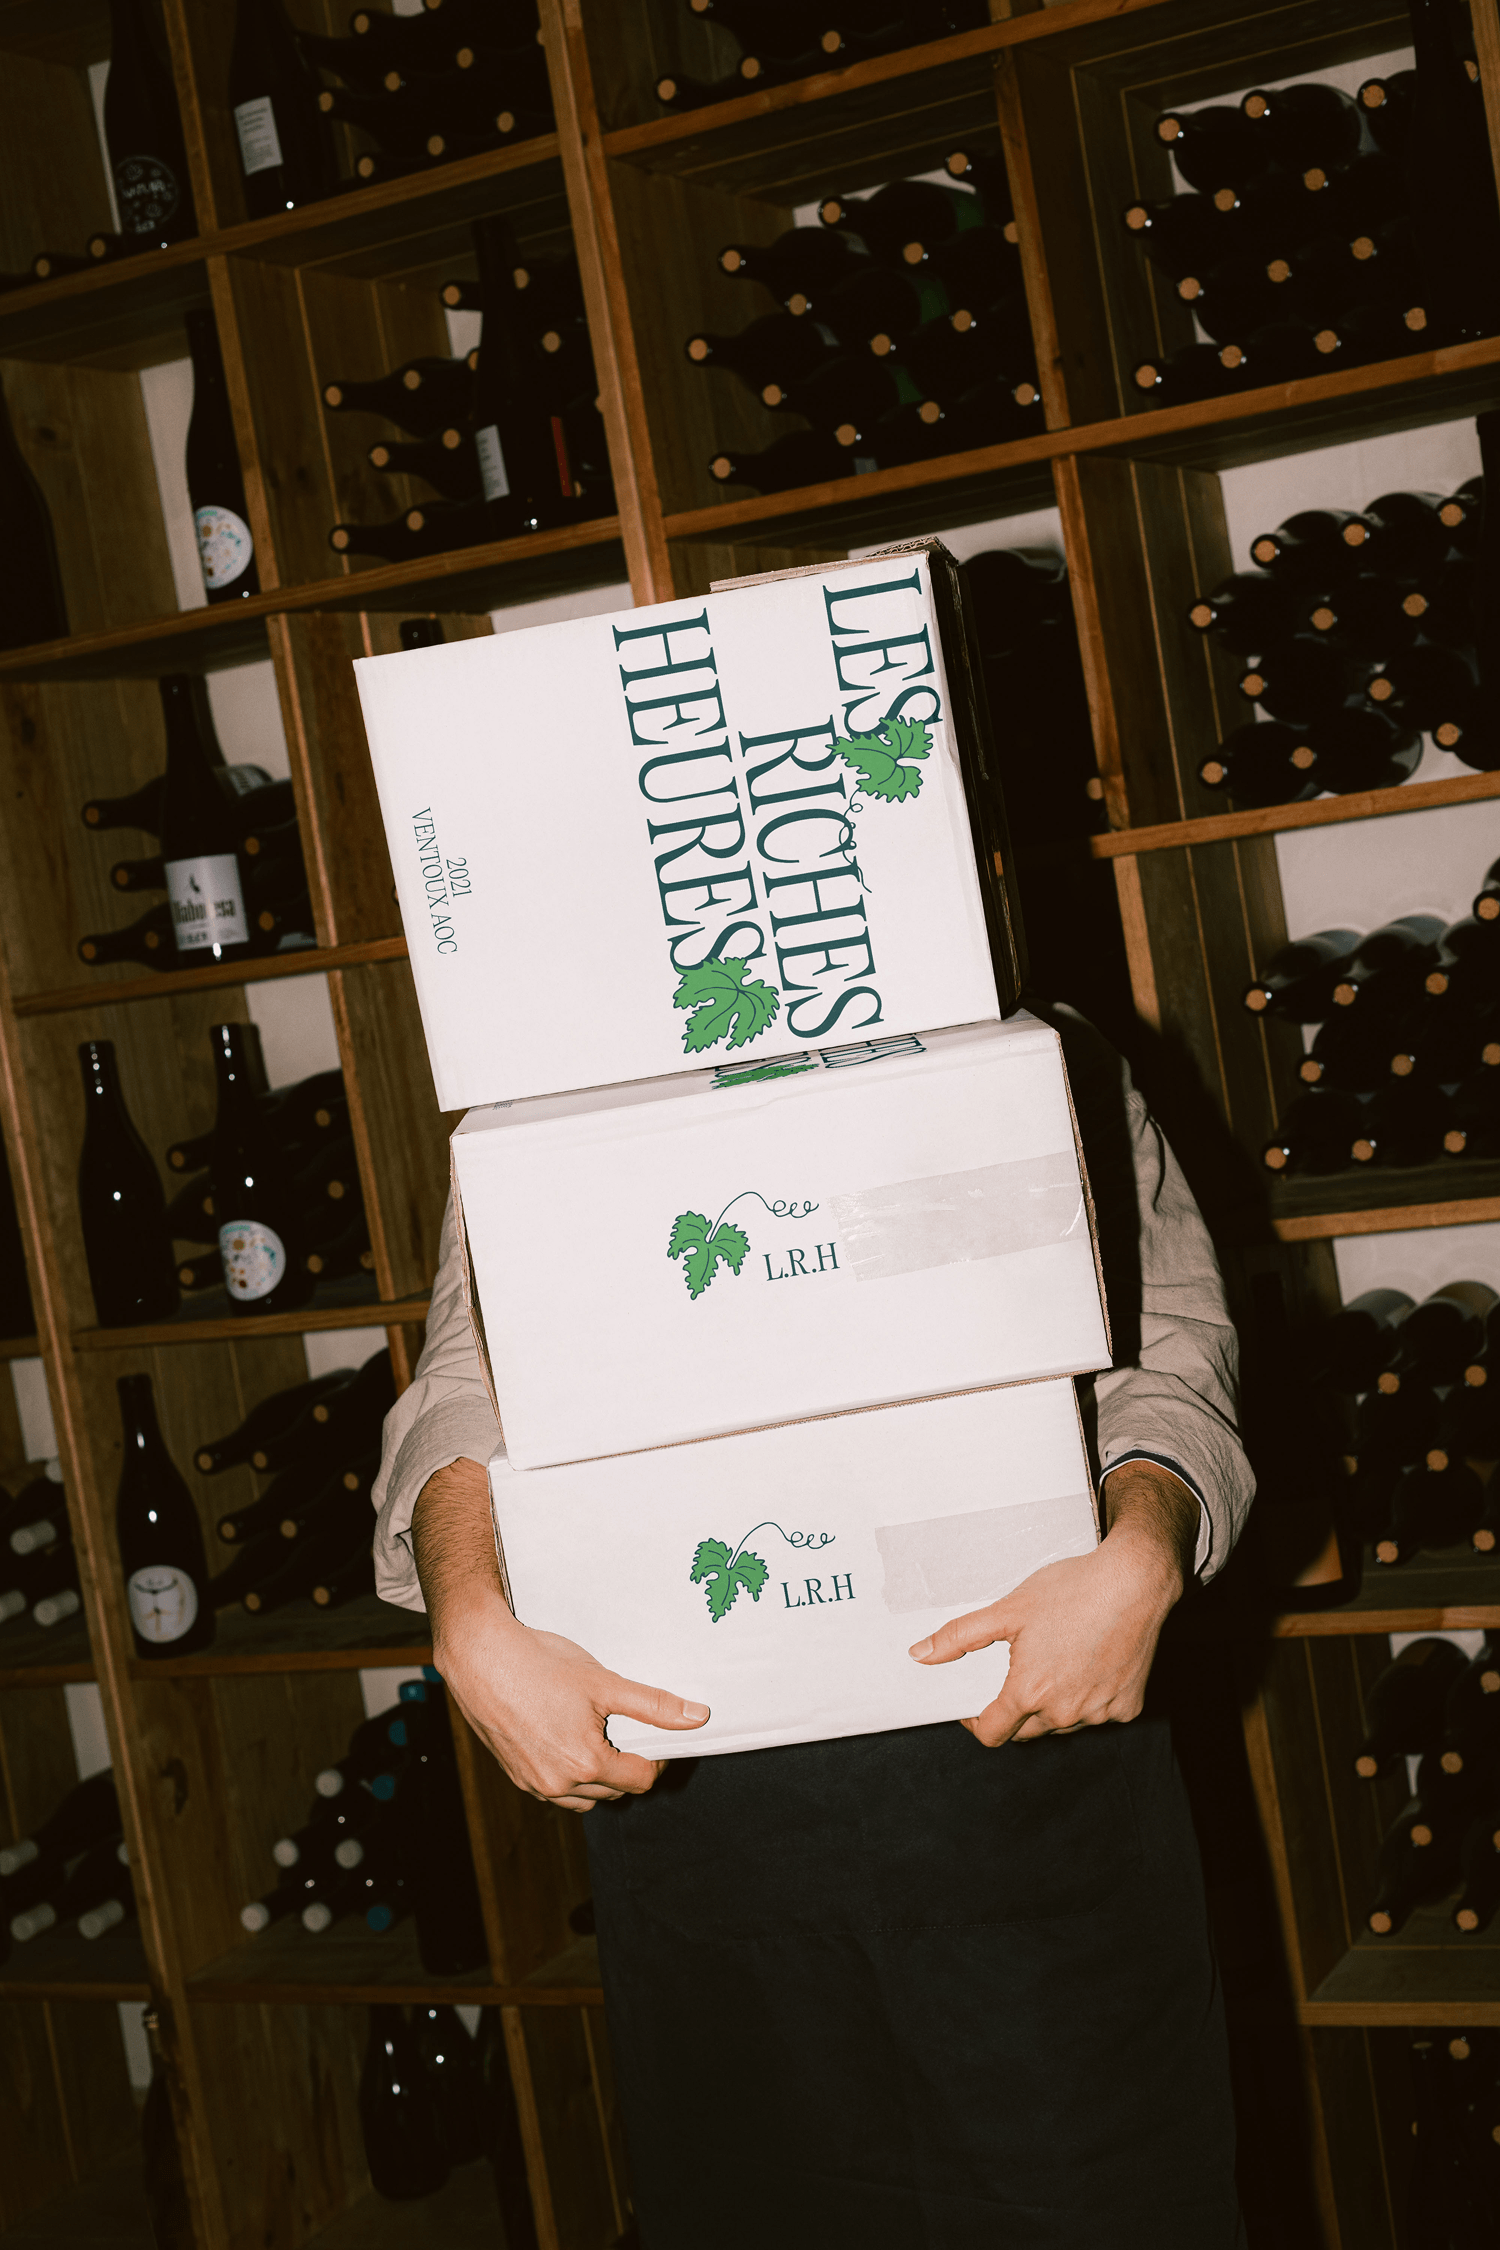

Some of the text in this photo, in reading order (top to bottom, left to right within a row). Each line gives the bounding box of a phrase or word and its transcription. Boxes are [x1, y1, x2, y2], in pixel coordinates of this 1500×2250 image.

[822, 567, 944, 736] LES
[611, 607, 768, 972] HEURES
[411, 806, 459, 955] VENTOUX AOC
[445, 856, 473, 898] 2021
[738, 714, 885, 1039] RICHES
[761, 1241, 841, 1282] L.R.H
[780, 1572, 857, 1609] L.R.H
